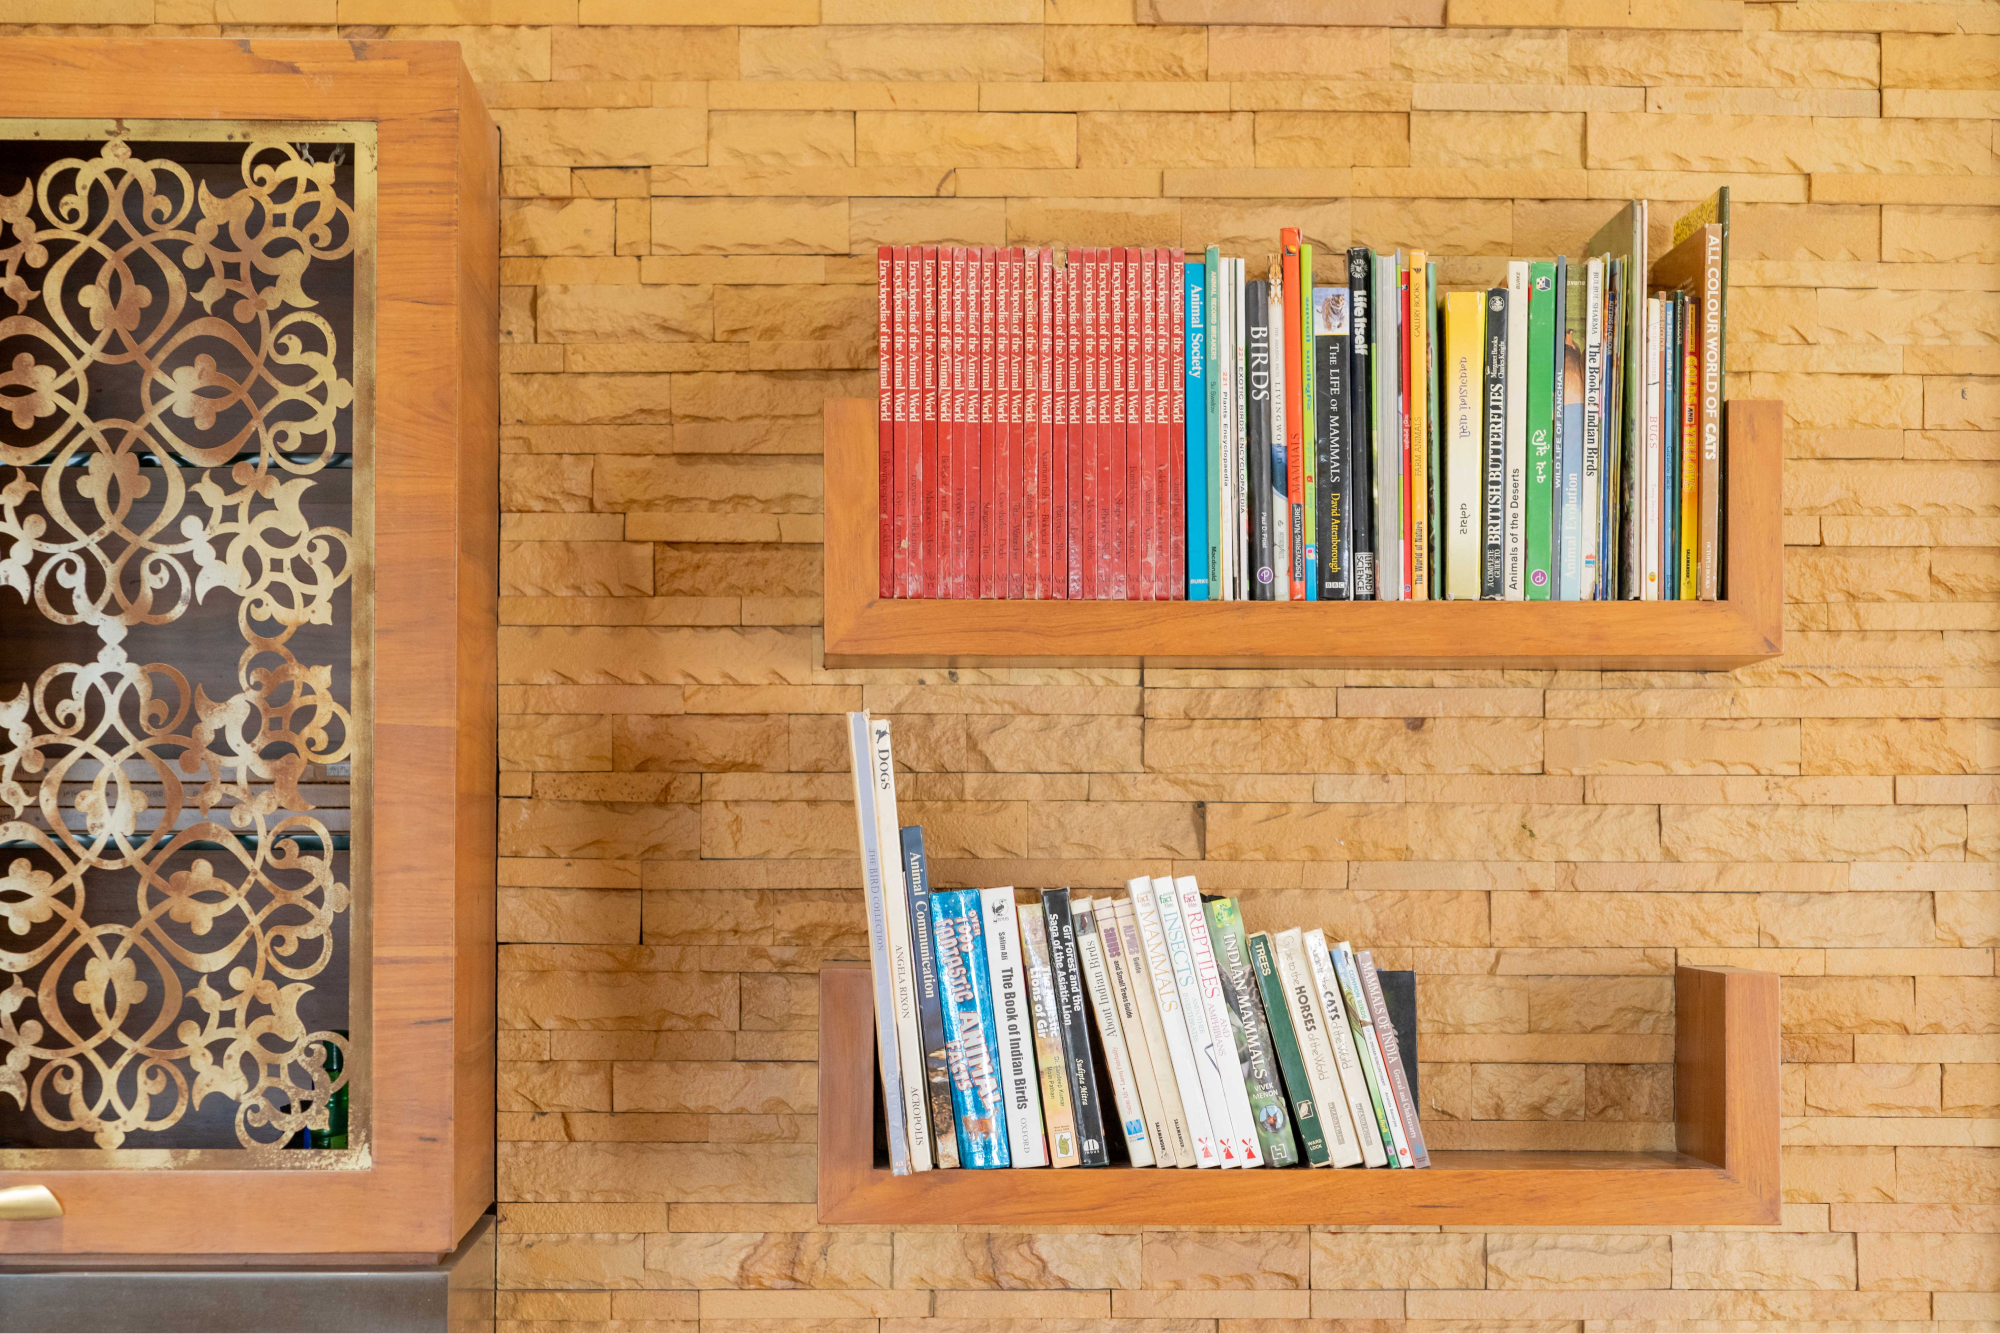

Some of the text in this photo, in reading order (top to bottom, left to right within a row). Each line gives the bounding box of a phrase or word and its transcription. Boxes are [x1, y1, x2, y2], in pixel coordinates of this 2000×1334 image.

[878, 260, 891, 421] Encyclopedia of the Animal World
[982, 262, 994, 423] Encyclopedia of the Animal World
[1112, 262, 1124, 423] Encyclopedia of the Animal World
[1188, 283, 1204, 378] Animal Society
[1251, 326, 1270, 400] BIRDS
[1705, 234, 1720, 460] ALL COLOUR WORLD OF CATS
[1330, 369, 1340, 395] LIFE
[1330, 398, 1337, 411] OF
[1586, 343, 1600, 477] The Book of Indian Birds
[1684, 355, 1697, 408] GOLDS
[1330, 415, 1340, 483] MAMMALS
[1557, 422, 1562, 435] OF
[1684, 425, 1696, 492] YELLOWS
[1291, 434, 1300, 493] MAMMALS
[1488, 383, 1504, 545] BRITISH BUTTERFLIES
[1329, 493, 1341, 573] David Attenborough
[1509, 468, 1519, 590] Animals of the Deserts
[1565, 473, 1578, 579] Animal Evolution
[1364, 556, 1372, 571] LIFE
[1415, 552, 1423, 572] World
[1415, 575, 1423, 585] The
[878, 749, 890, 790] DOGS
[868, 849, 884, 951] THE BIRD COLLECTION
[910, 852, 934, 998] Animal Communication
[968, 909, 981, 936] OVER
[1159, 895, 1173, 904] fact
[896, 945, 910, 1018] ANGELA RIXON
[1050, 914, 1071, 1026] Saga of the Asiatic Lion
[1063, 925, 1081, 1012] Gir Forest and the
[1123, 925, 1141, 974] ALPINES Guide
[1140, 910, 1178, 1012] MAMMALS
[1164, 911, 1194, 987] INSECTS
[1188, 911, 1220, 999] REPTILES
[1255, 942, 1271, 977] TREES
[1030, 968, 1047, 1038] Lions of Gir
[1086, 940, 1118, 1038] About Indian Birds
[1223, 933, 1268, 1079] INDIAN MAMMALS
[1349, 970, 1367, 1020] COMMON BIRDS
[1362, 961, 1398, 1064] MAMMALS OF INDIA
[959, 1012, 1001, 1110] ANIMAL
[1002, 967, 1027, 1110] The Book of Indian Birds
[1208, 1004, 1226, 1056] AMPHIBIANS
[1220, 1019, 1230, 1038] AND
[1324, 991, 1353, 1070] CATS of the World
[945, 1040, 973, 1092] FACTS
[1075, 1059, 1088, 1106] Sudipta Mitra
[1253, 1090, 1279, 1100] MENON
[1254, 1082, 1274, 1092] VIVEK
[911, 1087, 924, 1146] ACROPOLIS
[1020, 1118, 1030, 1153] OXFORD
[1155, 1121, 1165, 1150] SALAMANDER
[1174, 1119, 1184, 1147] SALAMANDER
[1393, 1069, 1416, 1138] Grewal and Chakravarty
[1308, 1139, 1322, 1147] WARD
